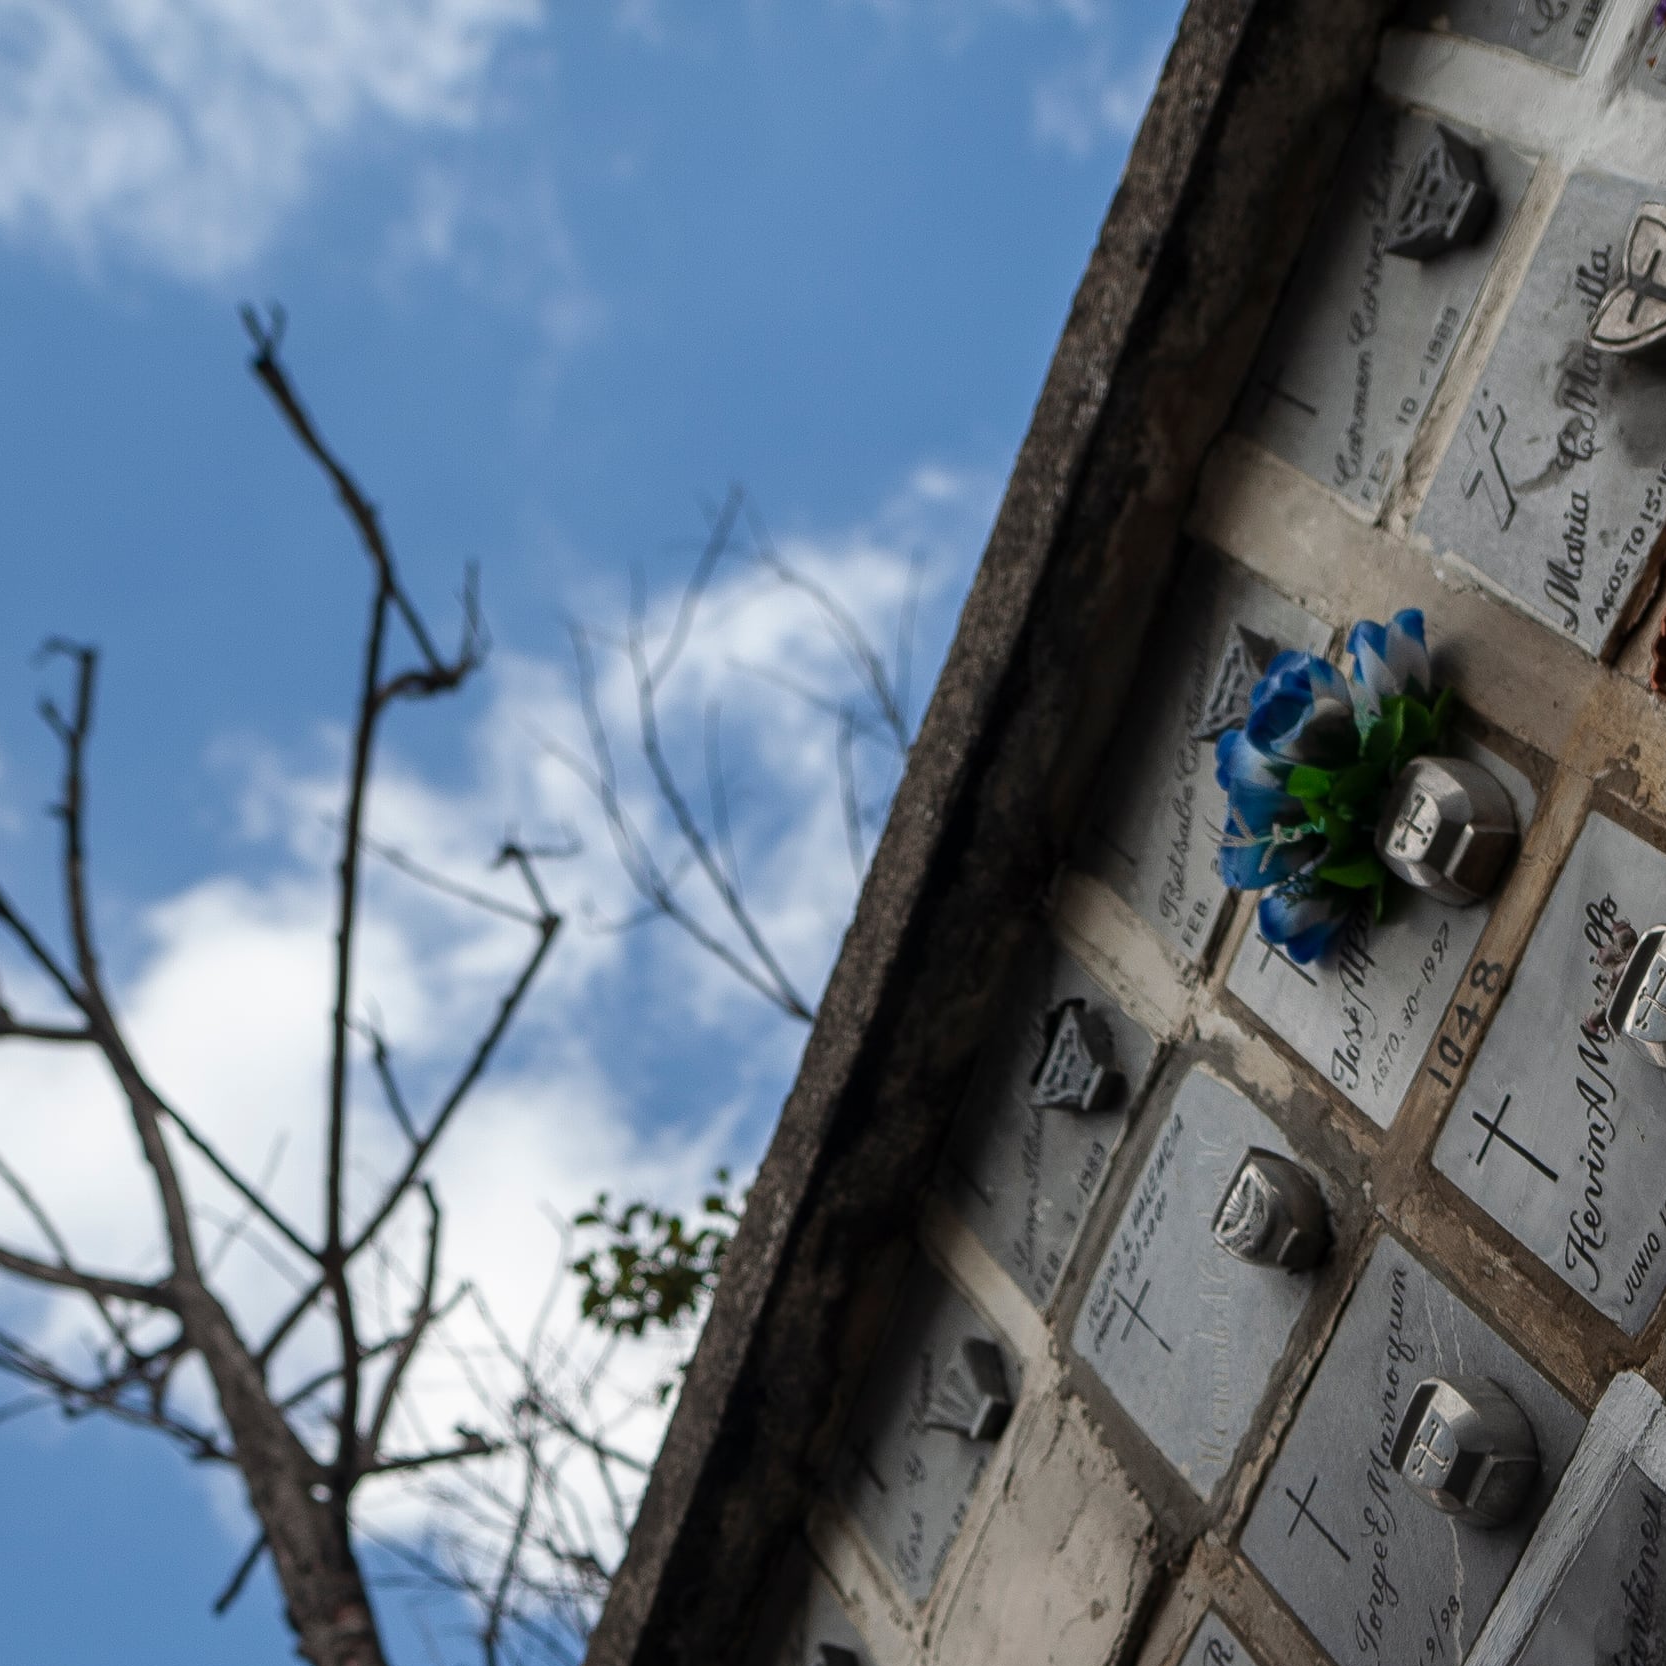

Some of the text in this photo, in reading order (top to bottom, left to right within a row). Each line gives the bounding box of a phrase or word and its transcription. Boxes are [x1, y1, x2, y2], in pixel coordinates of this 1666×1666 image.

[1546, 492, 1589, 628] Maria
[1595, 527, 1645, 624] AGOSTO
[1427, 960, 1503, 1089] 1048
[1565, 1123, 1616, 1293] Kevin
[1624, 1232, 1662, 1306] JUNIO
[1419, 1586, 1465, 1665] 9/98
